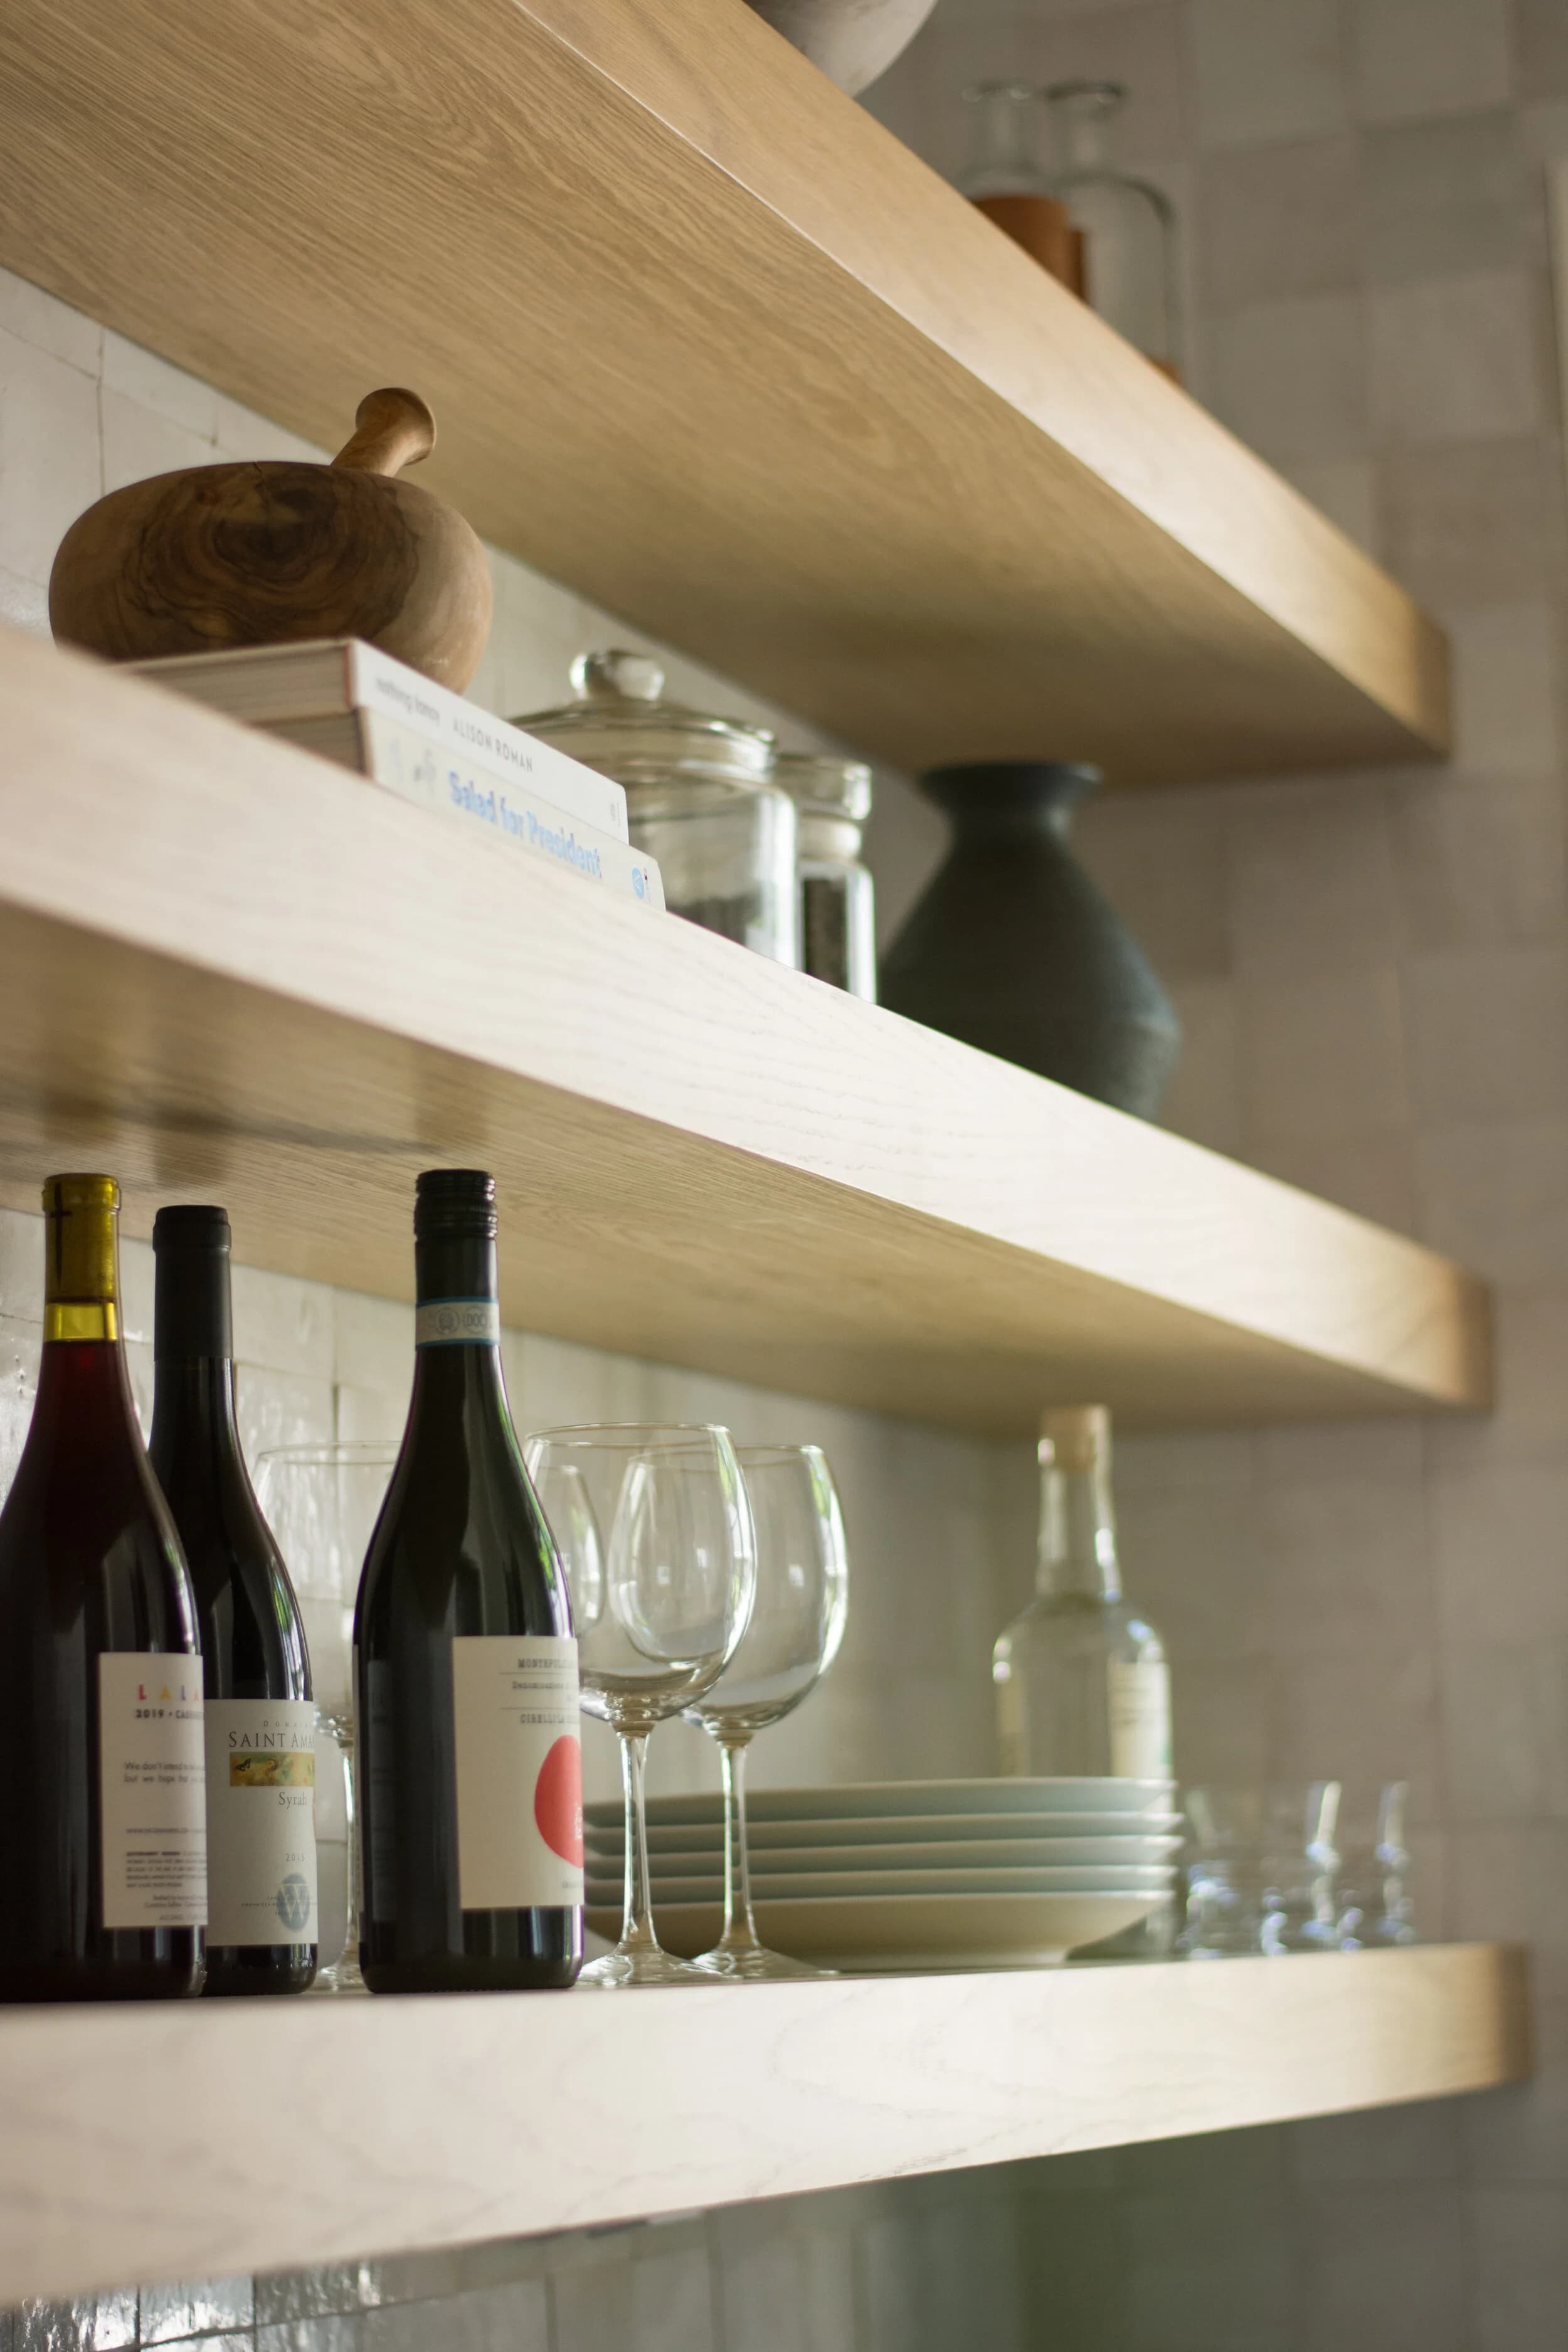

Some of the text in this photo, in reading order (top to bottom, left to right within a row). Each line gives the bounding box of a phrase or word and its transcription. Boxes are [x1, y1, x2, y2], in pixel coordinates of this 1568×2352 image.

[453, 717, 533, 773] ALISON ROMAN
[448, 770, 498, 824] Salad
[500, 795, 524, 840] for
[526, 810, 603, 879] President
[135, 1708, 165, 1720] 2019
[228, 1731, 287, 1748] SAINT
[278, 1791, 307, 1809] Syrah
[285, 1853, 306, 1862] 2015
